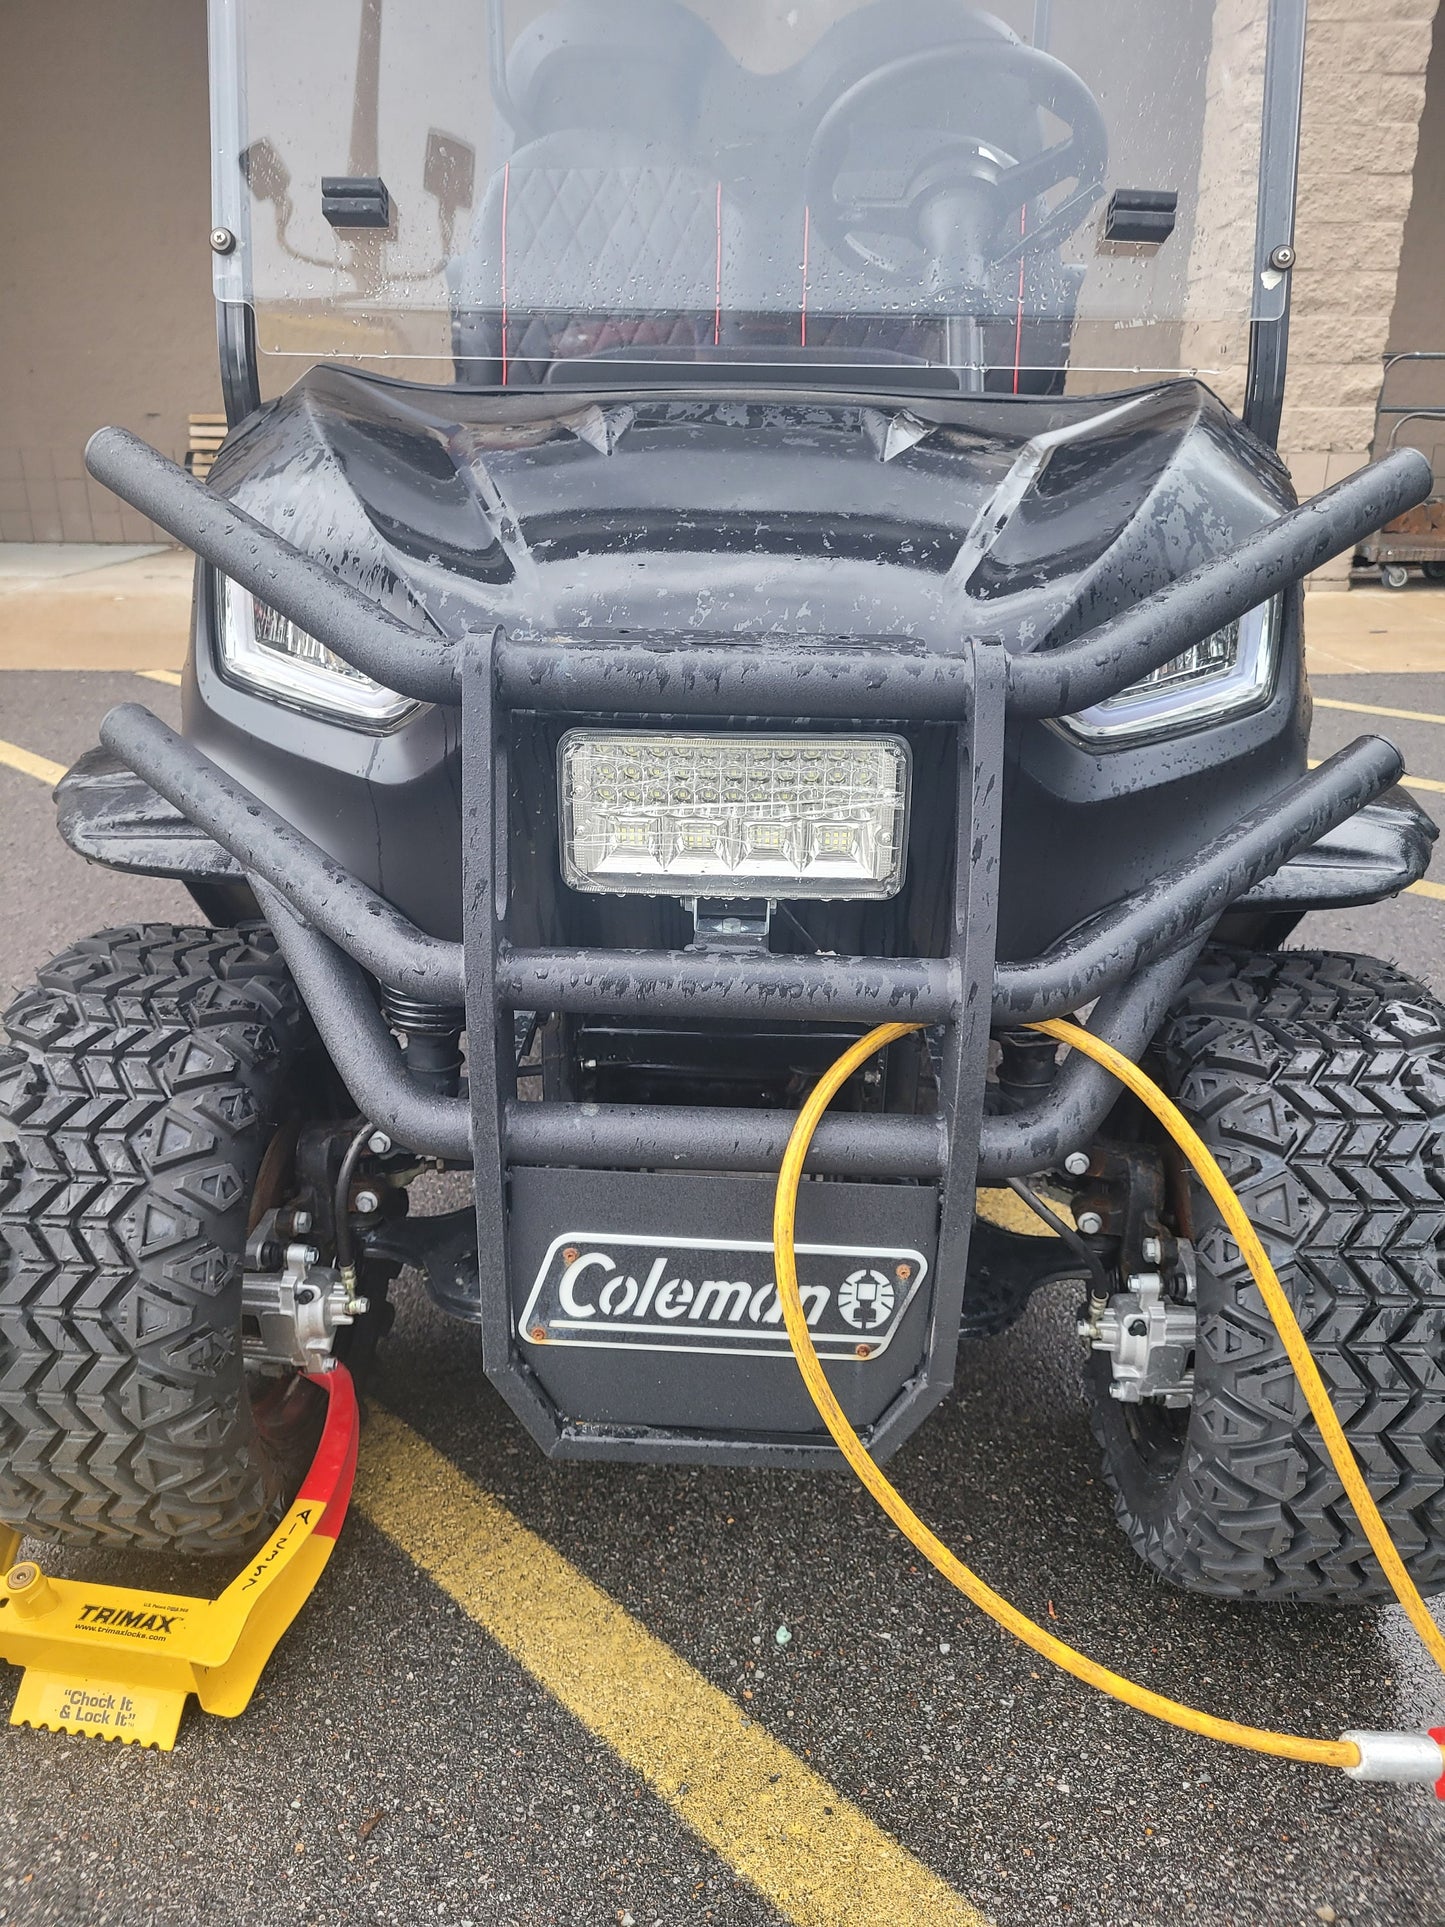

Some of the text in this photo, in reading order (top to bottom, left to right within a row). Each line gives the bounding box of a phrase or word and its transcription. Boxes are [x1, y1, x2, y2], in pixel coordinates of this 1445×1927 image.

[558, 1252, 831, 1326] Coleman
[78, 1604, 177, 1634] TRIMAX
[75, 1623, 167, 1642] www.trimaxlocks.com
[120, 1696, 133, 1712] It
[59, 1705, 71, 1719] &
[75, 1706, 110, 1725] Lock
